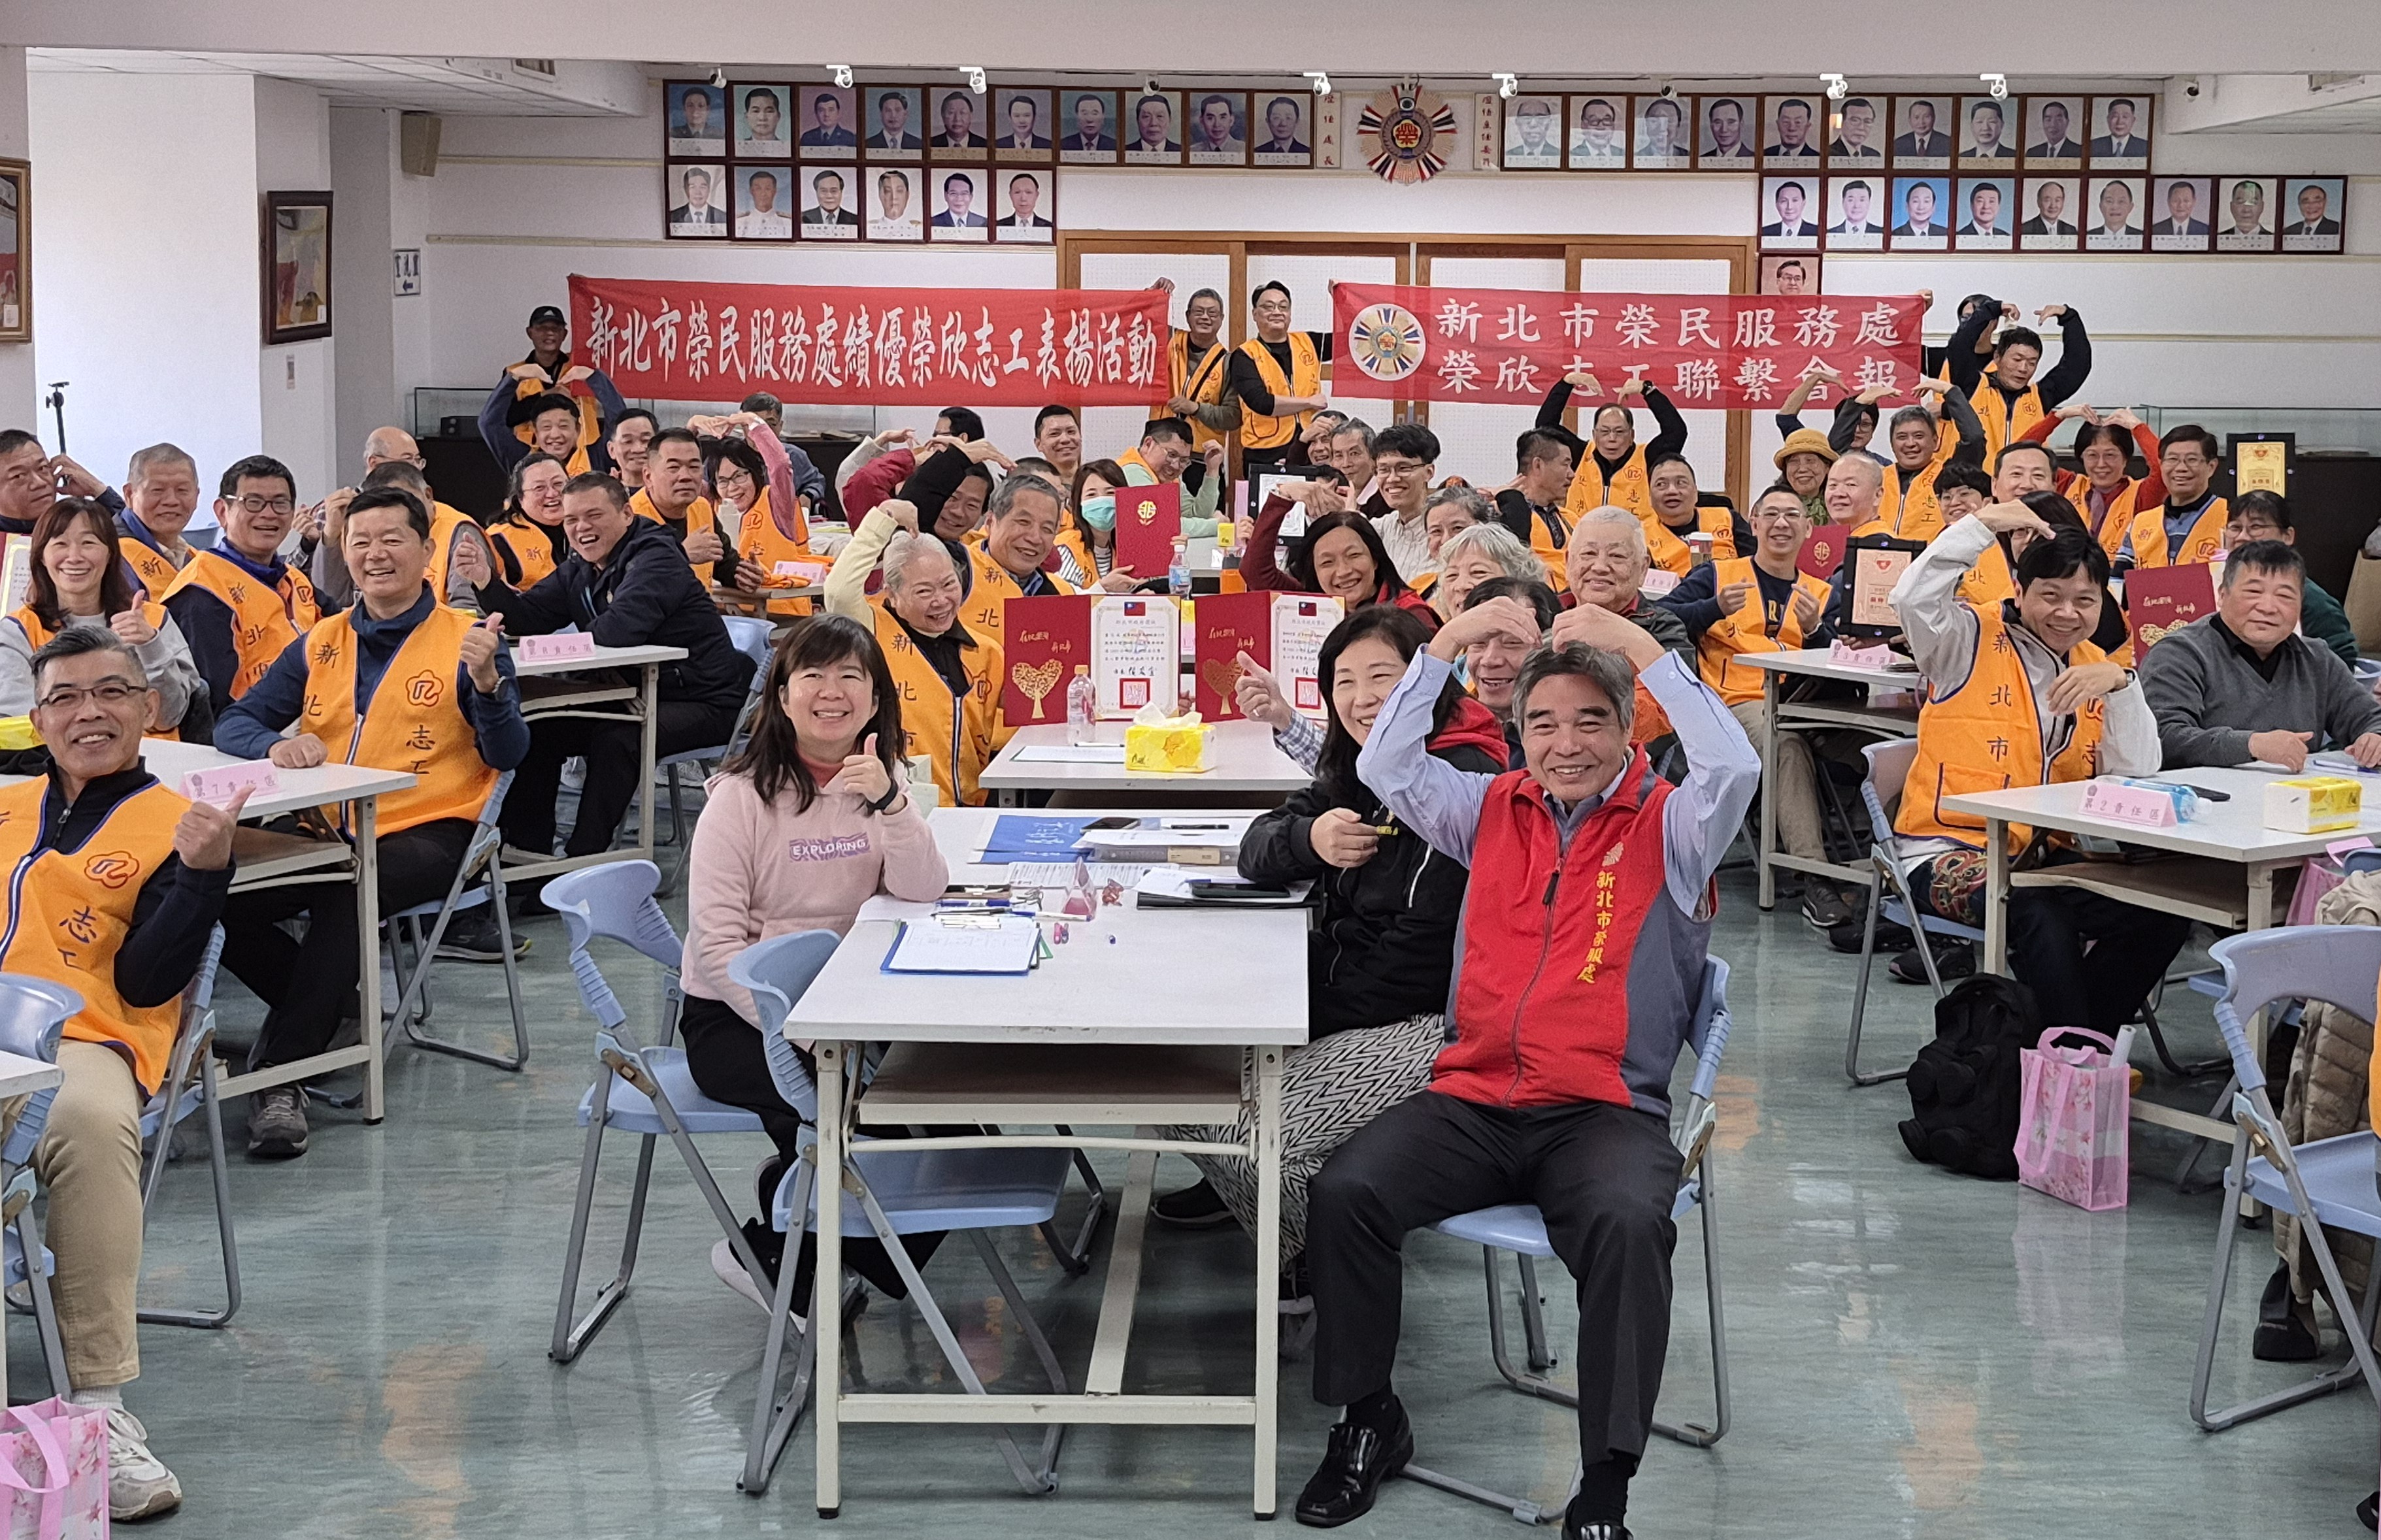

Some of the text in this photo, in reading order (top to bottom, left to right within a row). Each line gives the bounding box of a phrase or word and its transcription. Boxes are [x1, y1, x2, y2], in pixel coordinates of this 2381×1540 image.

[587, 297, 1156, 390] 新北市榮民服務處績優榮欣志工表揚活動
[1436, 297, 1903, 350] 新北市榮民服務處
[405, 724, 436, 775] 志工
[792, 838, 867, 857] EXPLORING
[1576, 870, 1616, 984] 新北市榮服處
